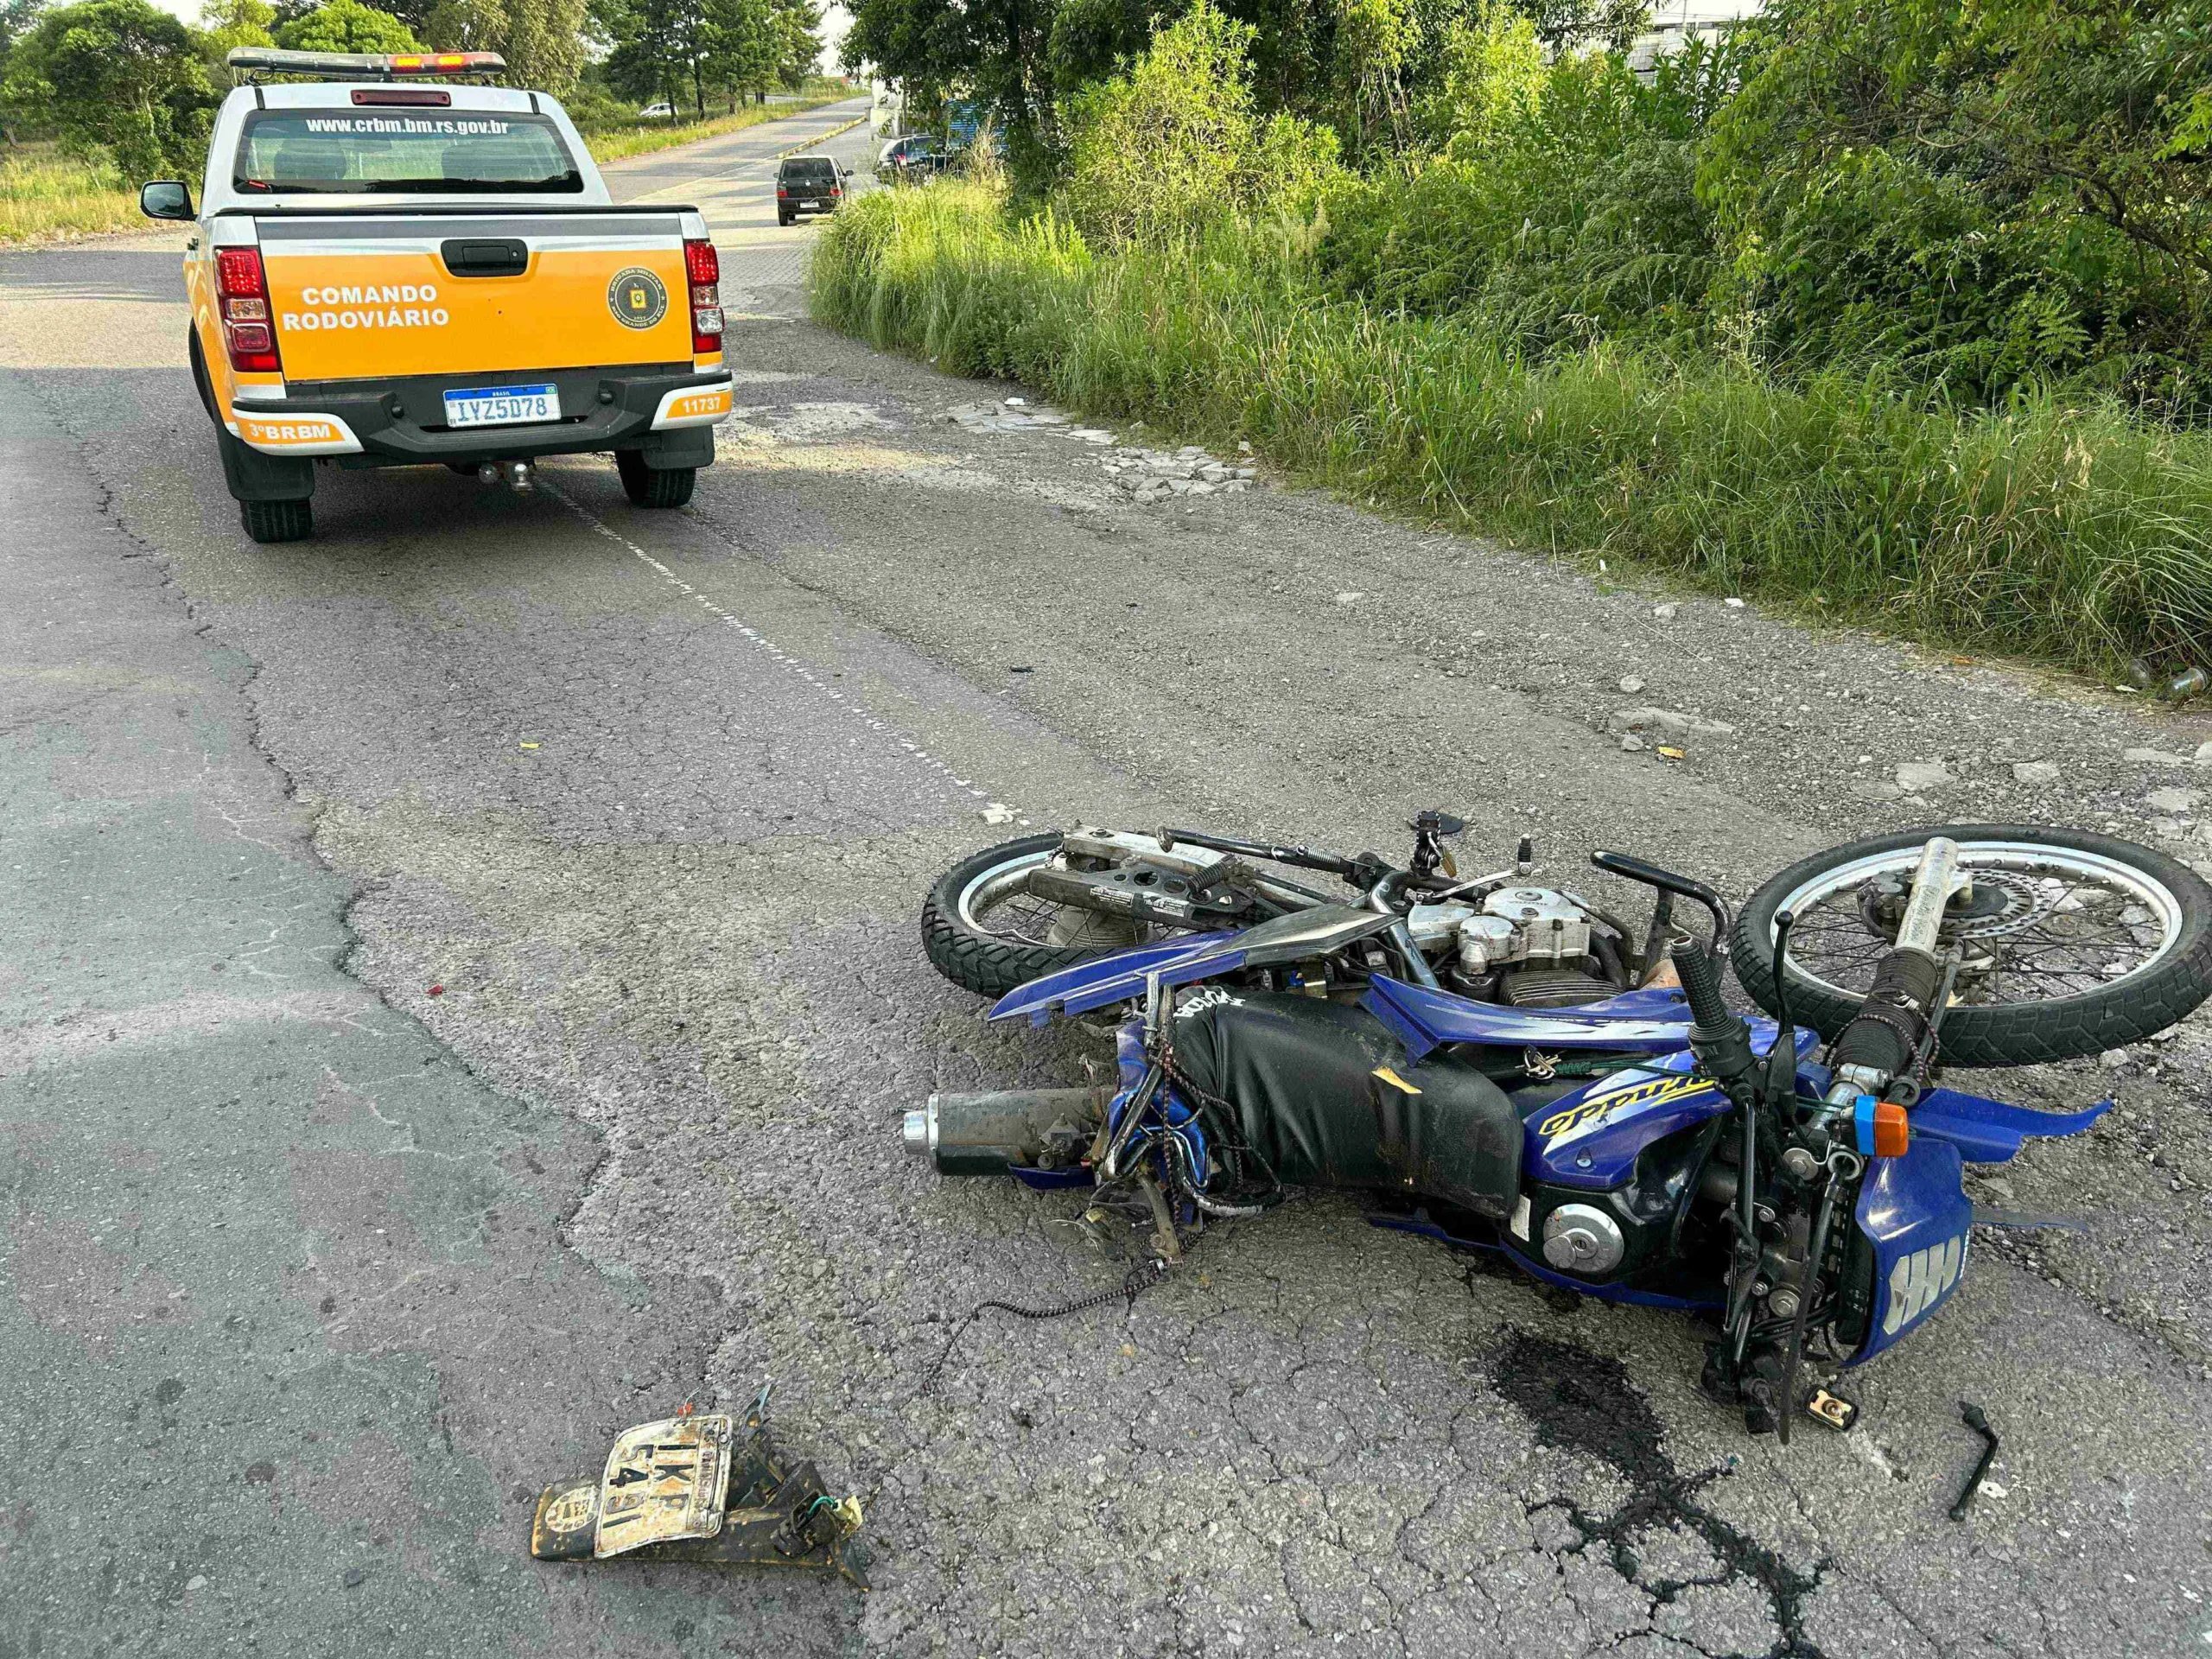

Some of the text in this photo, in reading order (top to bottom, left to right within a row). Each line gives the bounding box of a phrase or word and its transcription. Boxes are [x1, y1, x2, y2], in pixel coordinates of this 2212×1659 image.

[306, 118, 509, 135] www.crbm.bm.rs.gov.br
[610, 269, 663, 291] BRIGADA MILITAR
[302, 284, 437, 305] COMANDO
[282, 306, 449, 331] RODOVIÁRIO
[612, 305, 665, 327] RIO GRANDE DO SUL
[458, 397, 548, 422] IYZ5D78
[683, 396, 721, 413] 11737
[650, 1444, 698, 1510] IKP
